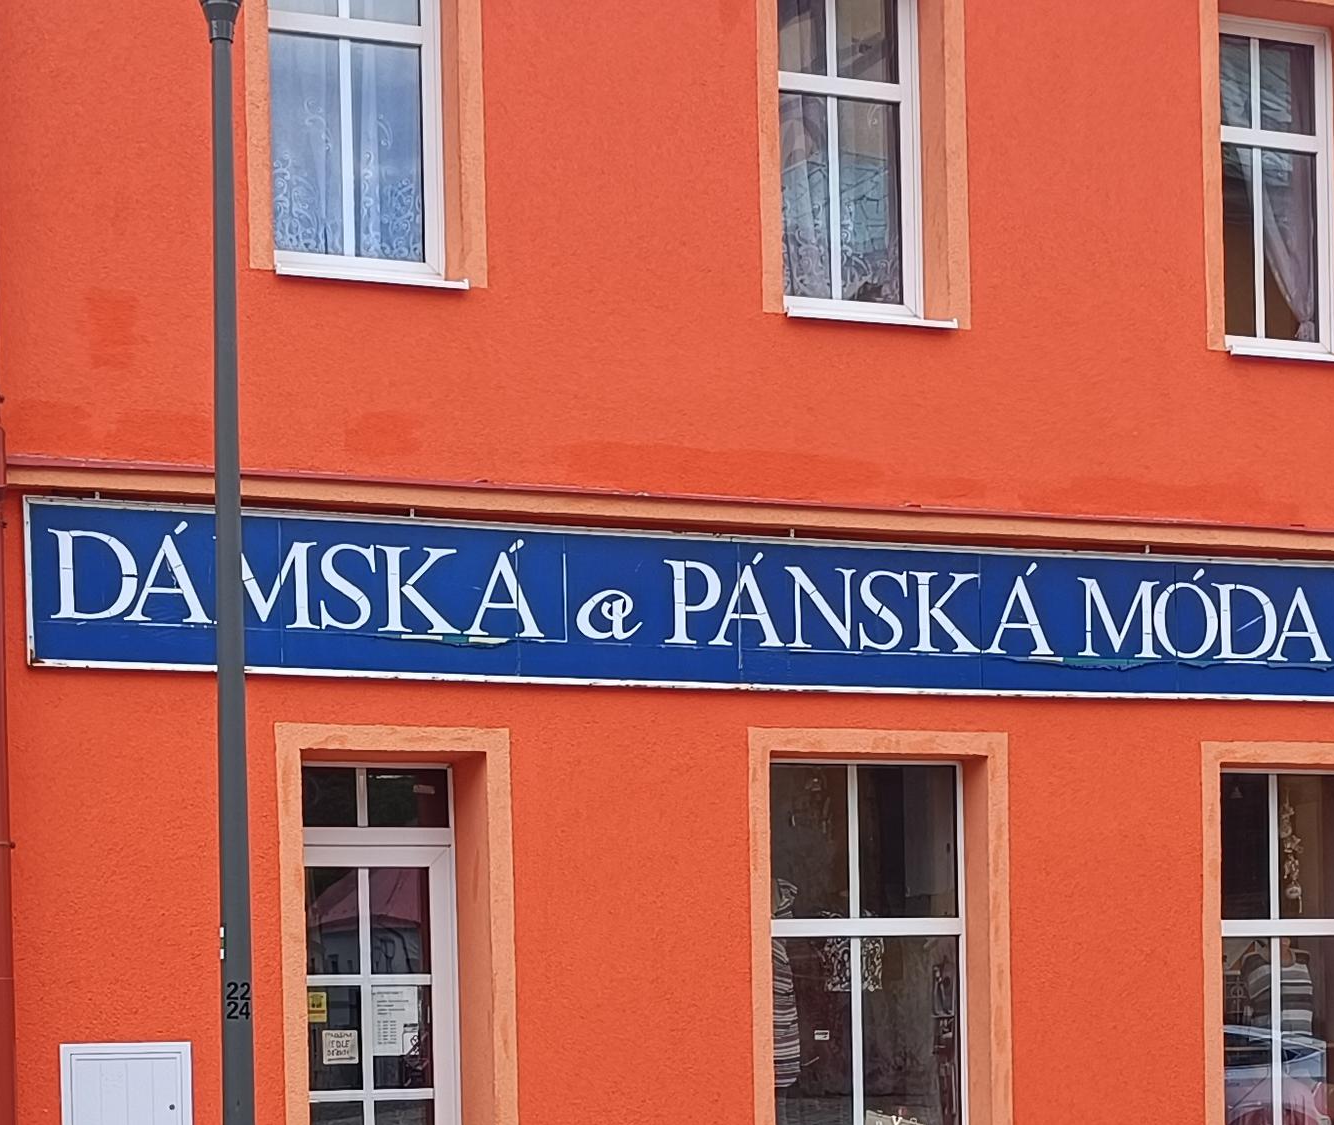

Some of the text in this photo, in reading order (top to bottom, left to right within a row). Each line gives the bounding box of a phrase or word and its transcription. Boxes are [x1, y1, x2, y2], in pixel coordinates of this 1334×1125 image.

[47, 521, 547, 639] DÁMSKÁ
[663, 548, 1055, 657] PÁNSKÁ
[1076, 567, 1333, 663] MÓDA
[226, 981, 251, 1001] 22
[226, 1001, 251, 1020] 24
